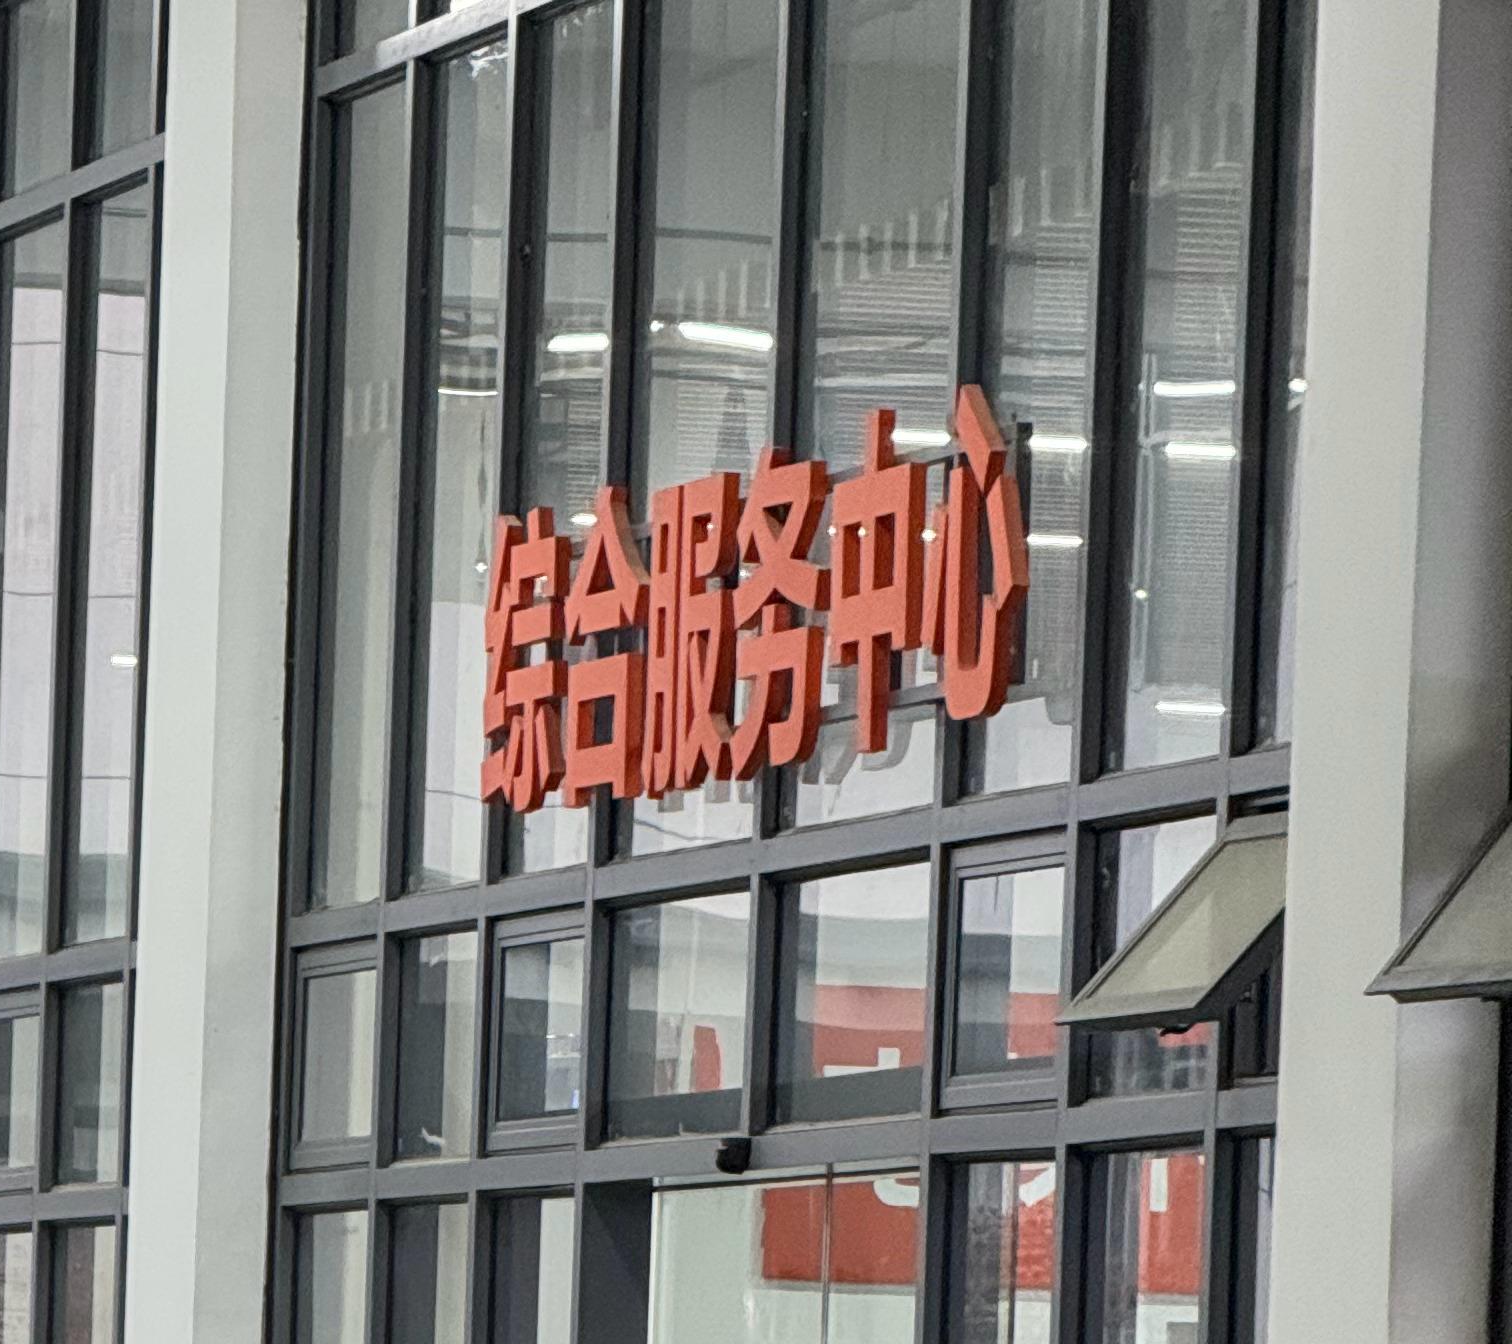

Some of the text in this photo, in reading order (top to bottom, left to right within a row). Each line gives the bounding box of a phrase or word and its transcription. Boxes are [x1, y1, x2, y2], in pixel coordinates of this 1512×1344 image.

[482, 383, 1029, 812] 综合服务中心
